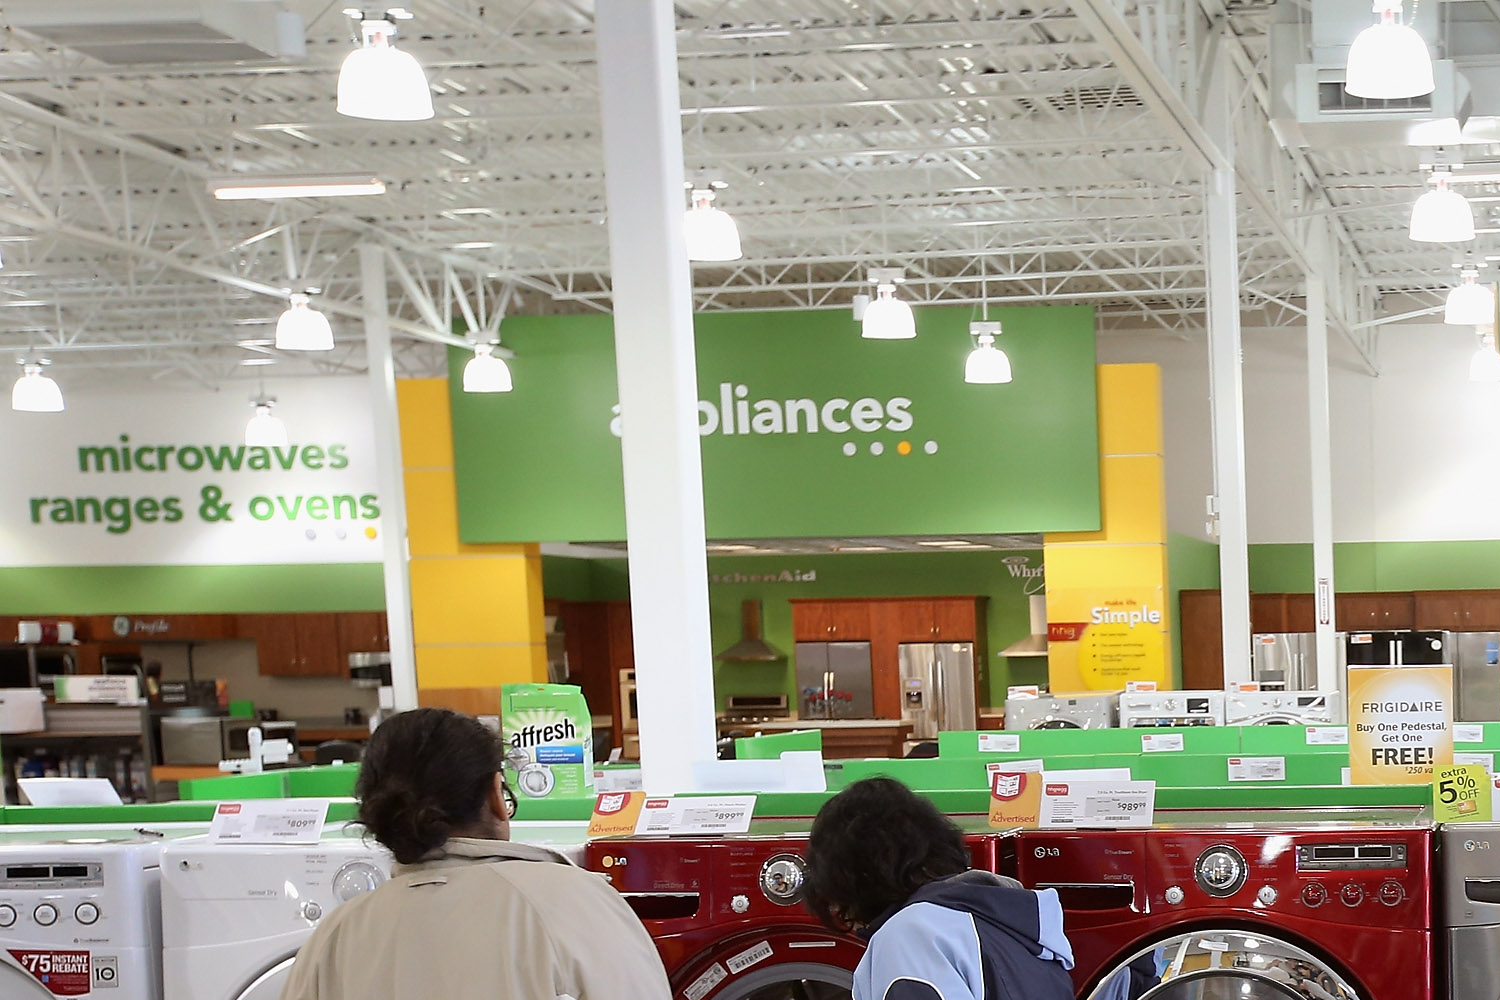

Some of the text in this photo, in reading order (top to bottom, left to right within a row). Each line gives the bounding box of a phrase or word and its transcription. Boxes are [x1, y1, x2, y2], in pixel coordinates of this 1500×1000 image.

[77, 434, 349, 472] microwaves
[29, 485, 381, 534] ranges & ovens
[1091, 605, 1160, 628] Simple
[1362, 702, 1443, 713] FRIGIDAIRE
[511, 718, 575, 749] affresh
[1356, 722, 1447, 733] Buy One Pedestal,
[1381, 733, 1423, 743] Get One
[1371, 747, 1434, 766] FREE!
[1441, 766, 1467, 779] extra
[1439, 776, 1475, 803] 5%
[1459, 789, 1480, 801] OFF
[991, 815, 1035, 824] Advertised
[590, 825, 634, 833] Advertised
[22, 954, 88, 973] $75 INSTANT
[52, 964, 88, 973] REBATE
[95, 967, 115, 981] 10
